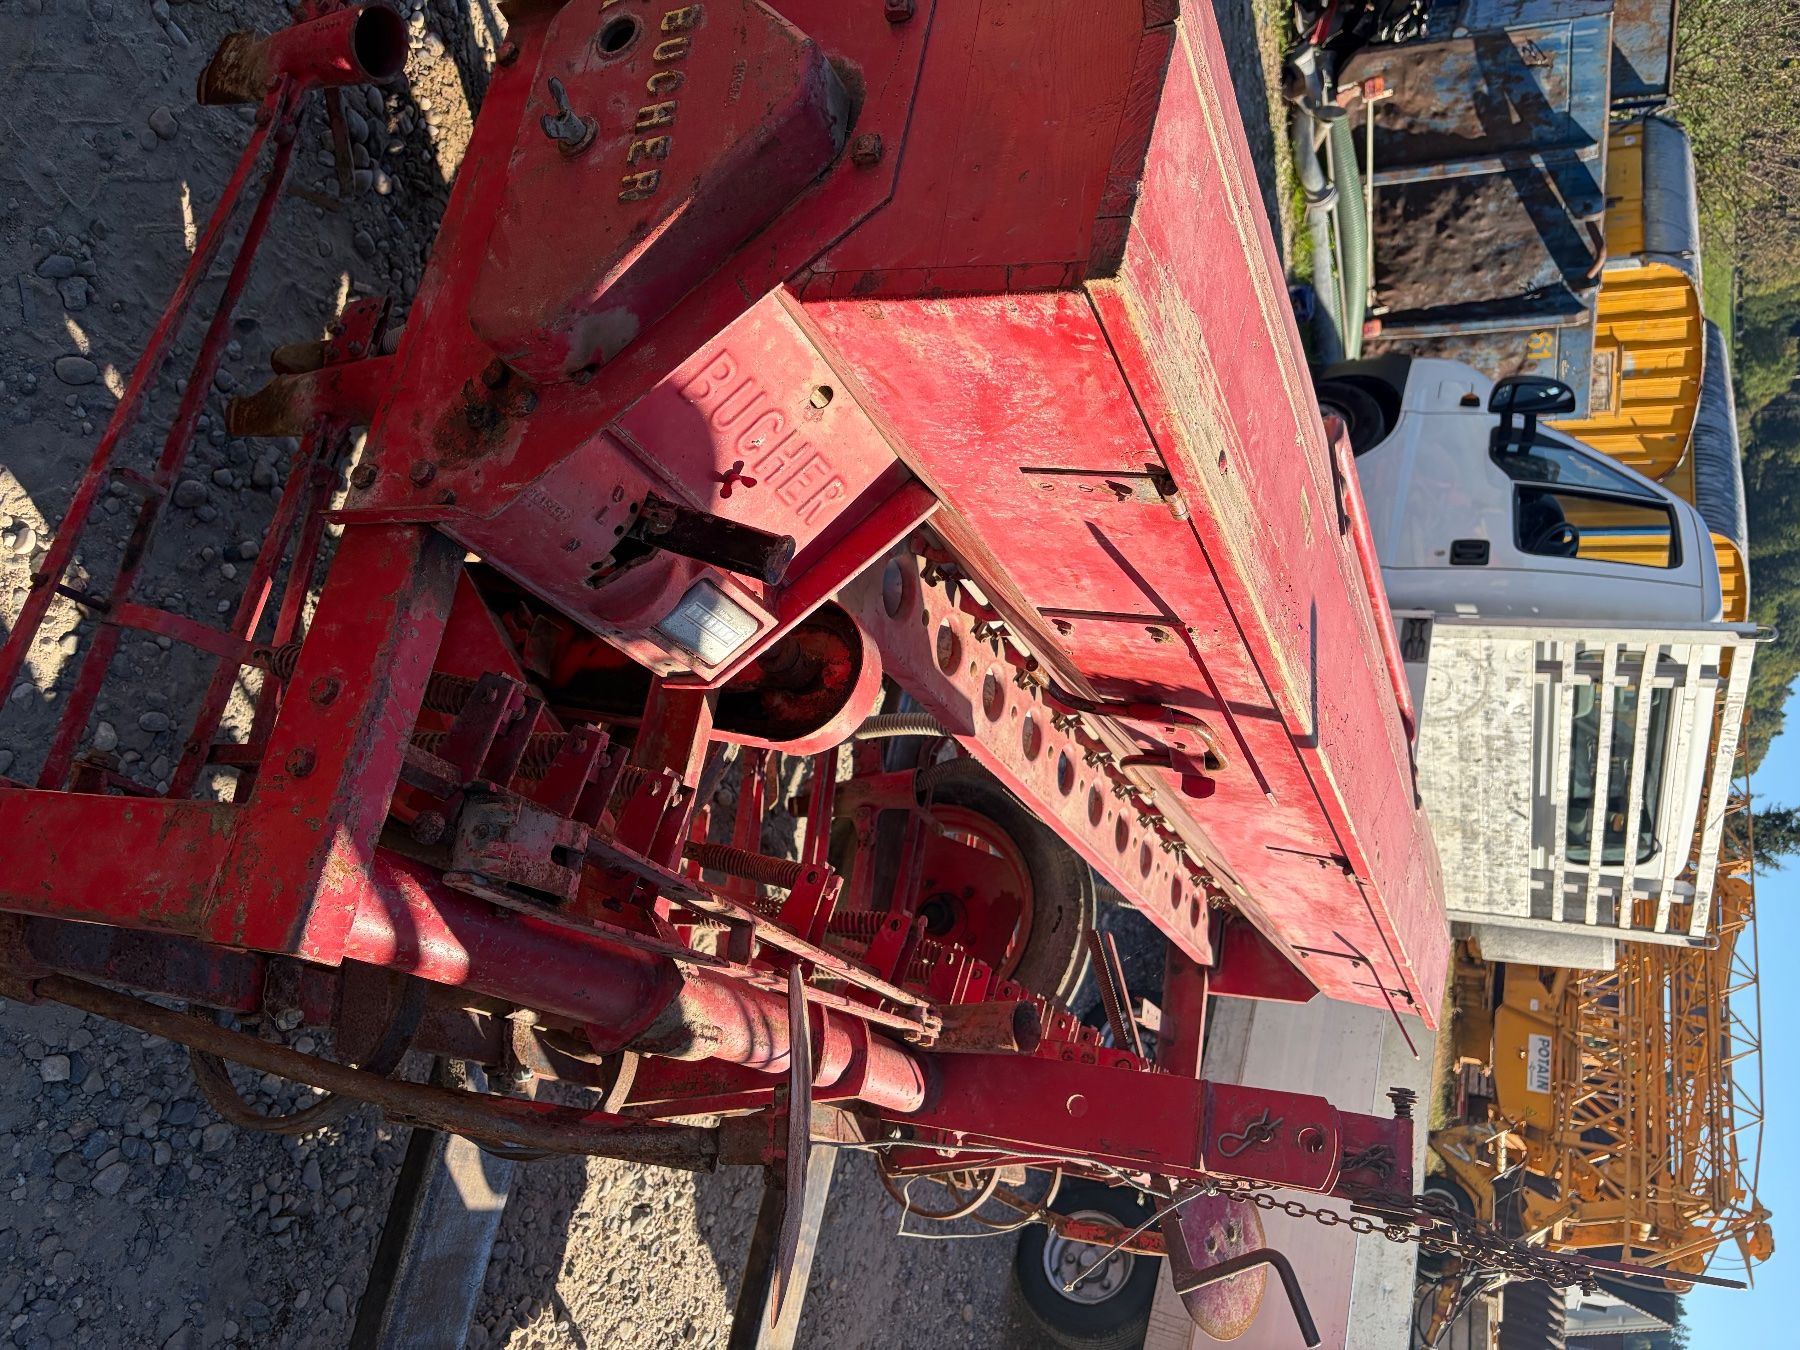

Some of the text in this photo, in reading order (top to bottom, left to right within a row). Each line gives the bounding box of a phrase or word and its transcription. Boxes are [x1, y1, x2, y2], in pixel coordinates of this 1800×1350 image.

[617, 4, 705, 202] BUCHER
[677, 347, 848, 527] BUCHER
[1536, 1037, 1551, 1092] POTAIN
